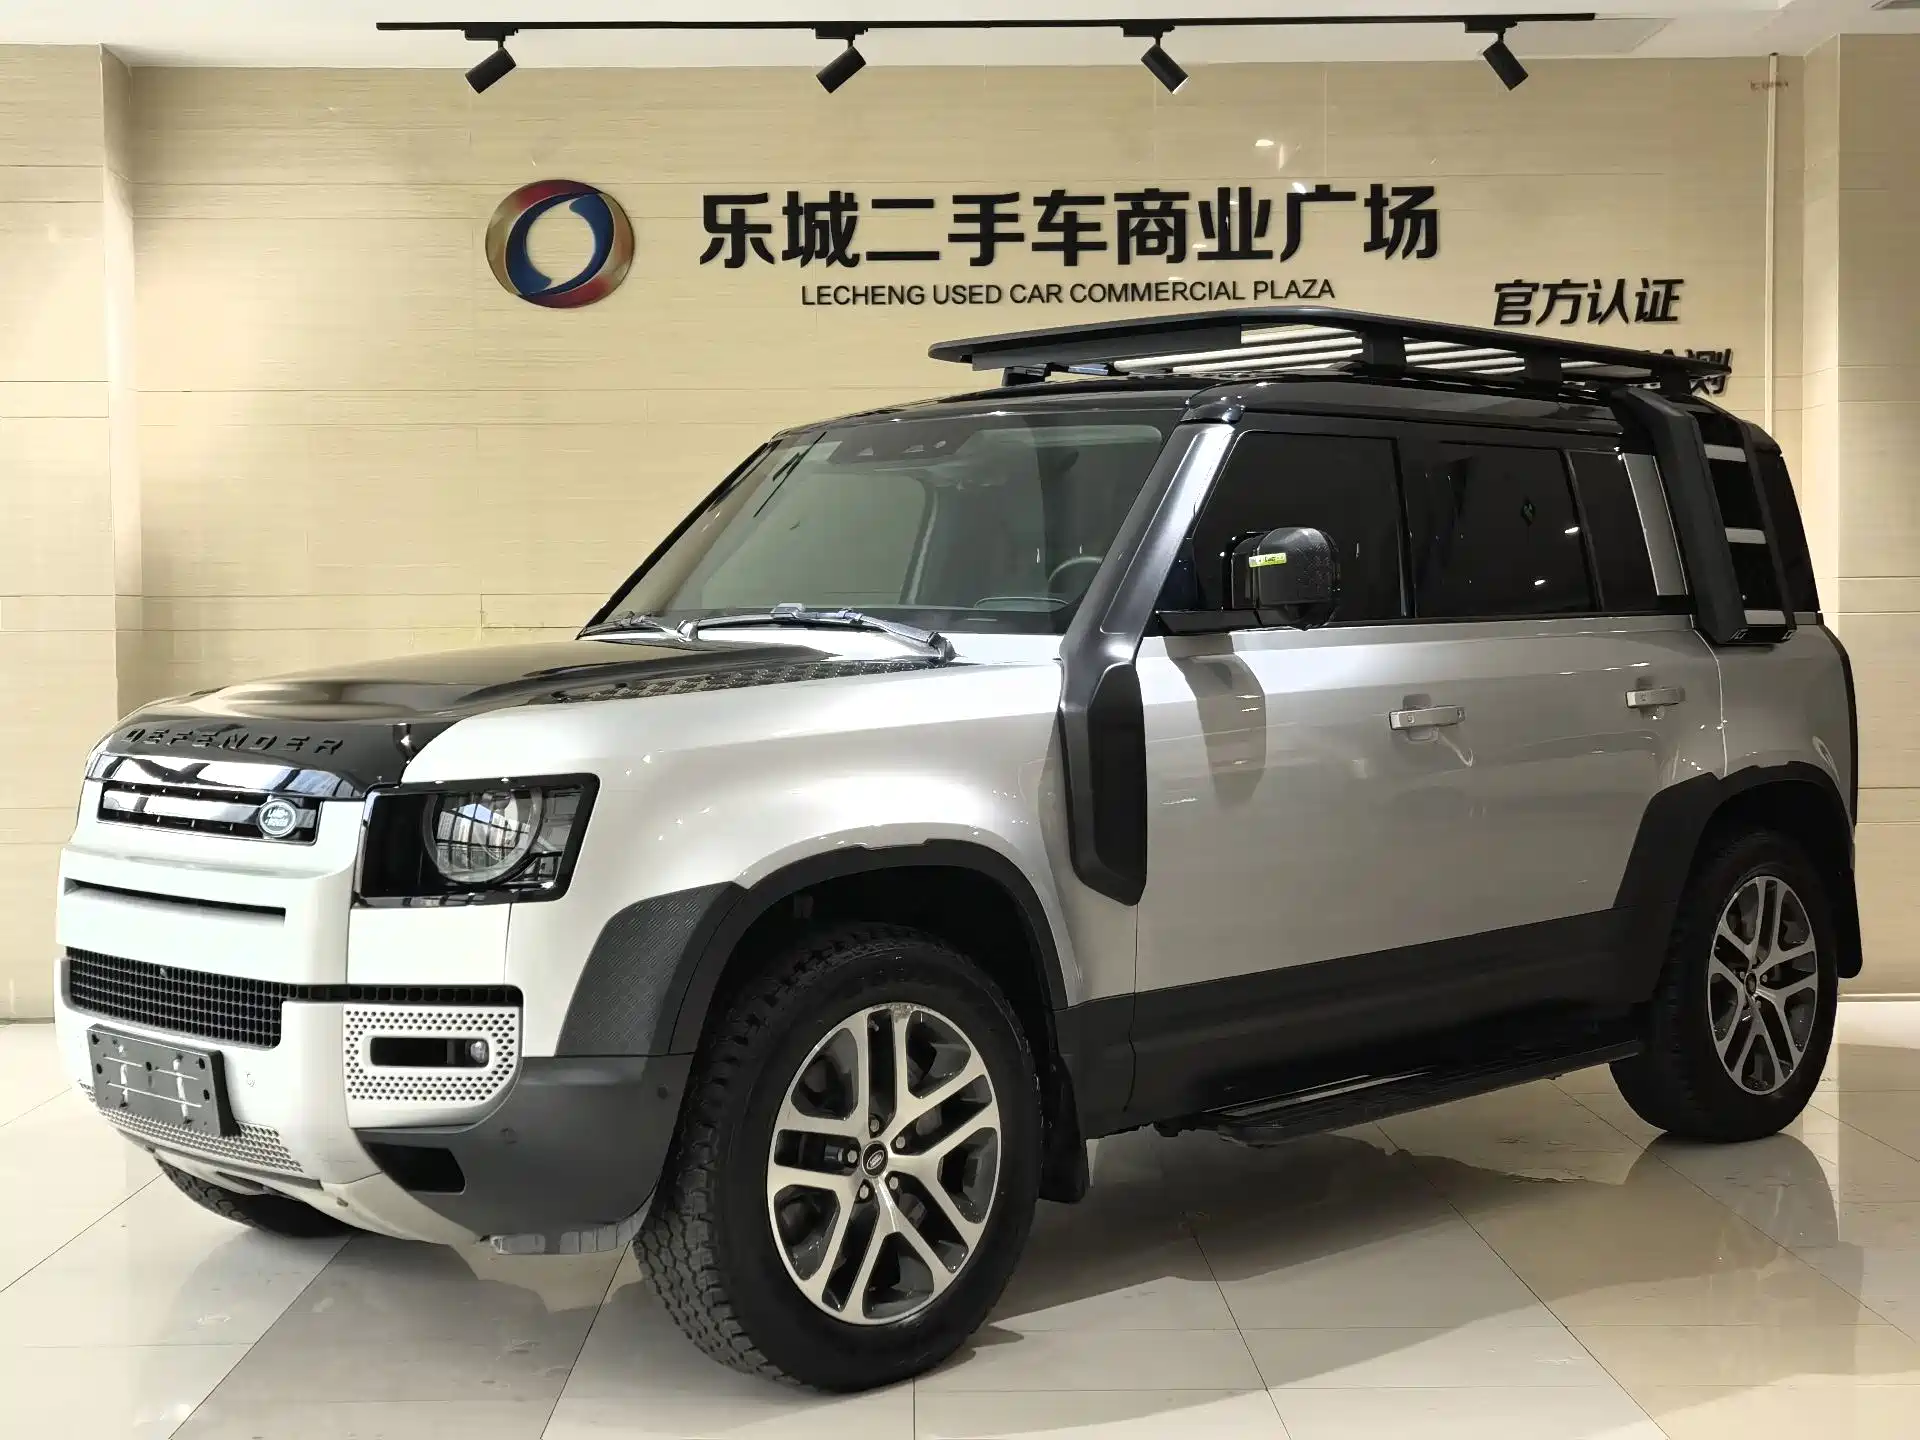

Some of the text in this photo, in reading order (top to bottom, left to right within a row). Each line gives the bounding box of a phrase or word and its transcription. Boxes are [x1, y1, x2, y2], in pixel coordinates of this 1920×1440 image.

[699, 183, 1438, 269] 乐城二手车商业广场
[801, 278, 1336, 306] LECHENG USED CAR COMMERCIAL PLAZA
[1493, 277, 1685, 326] 官方认证
[120, 727, 345, 756] DEFENDER
